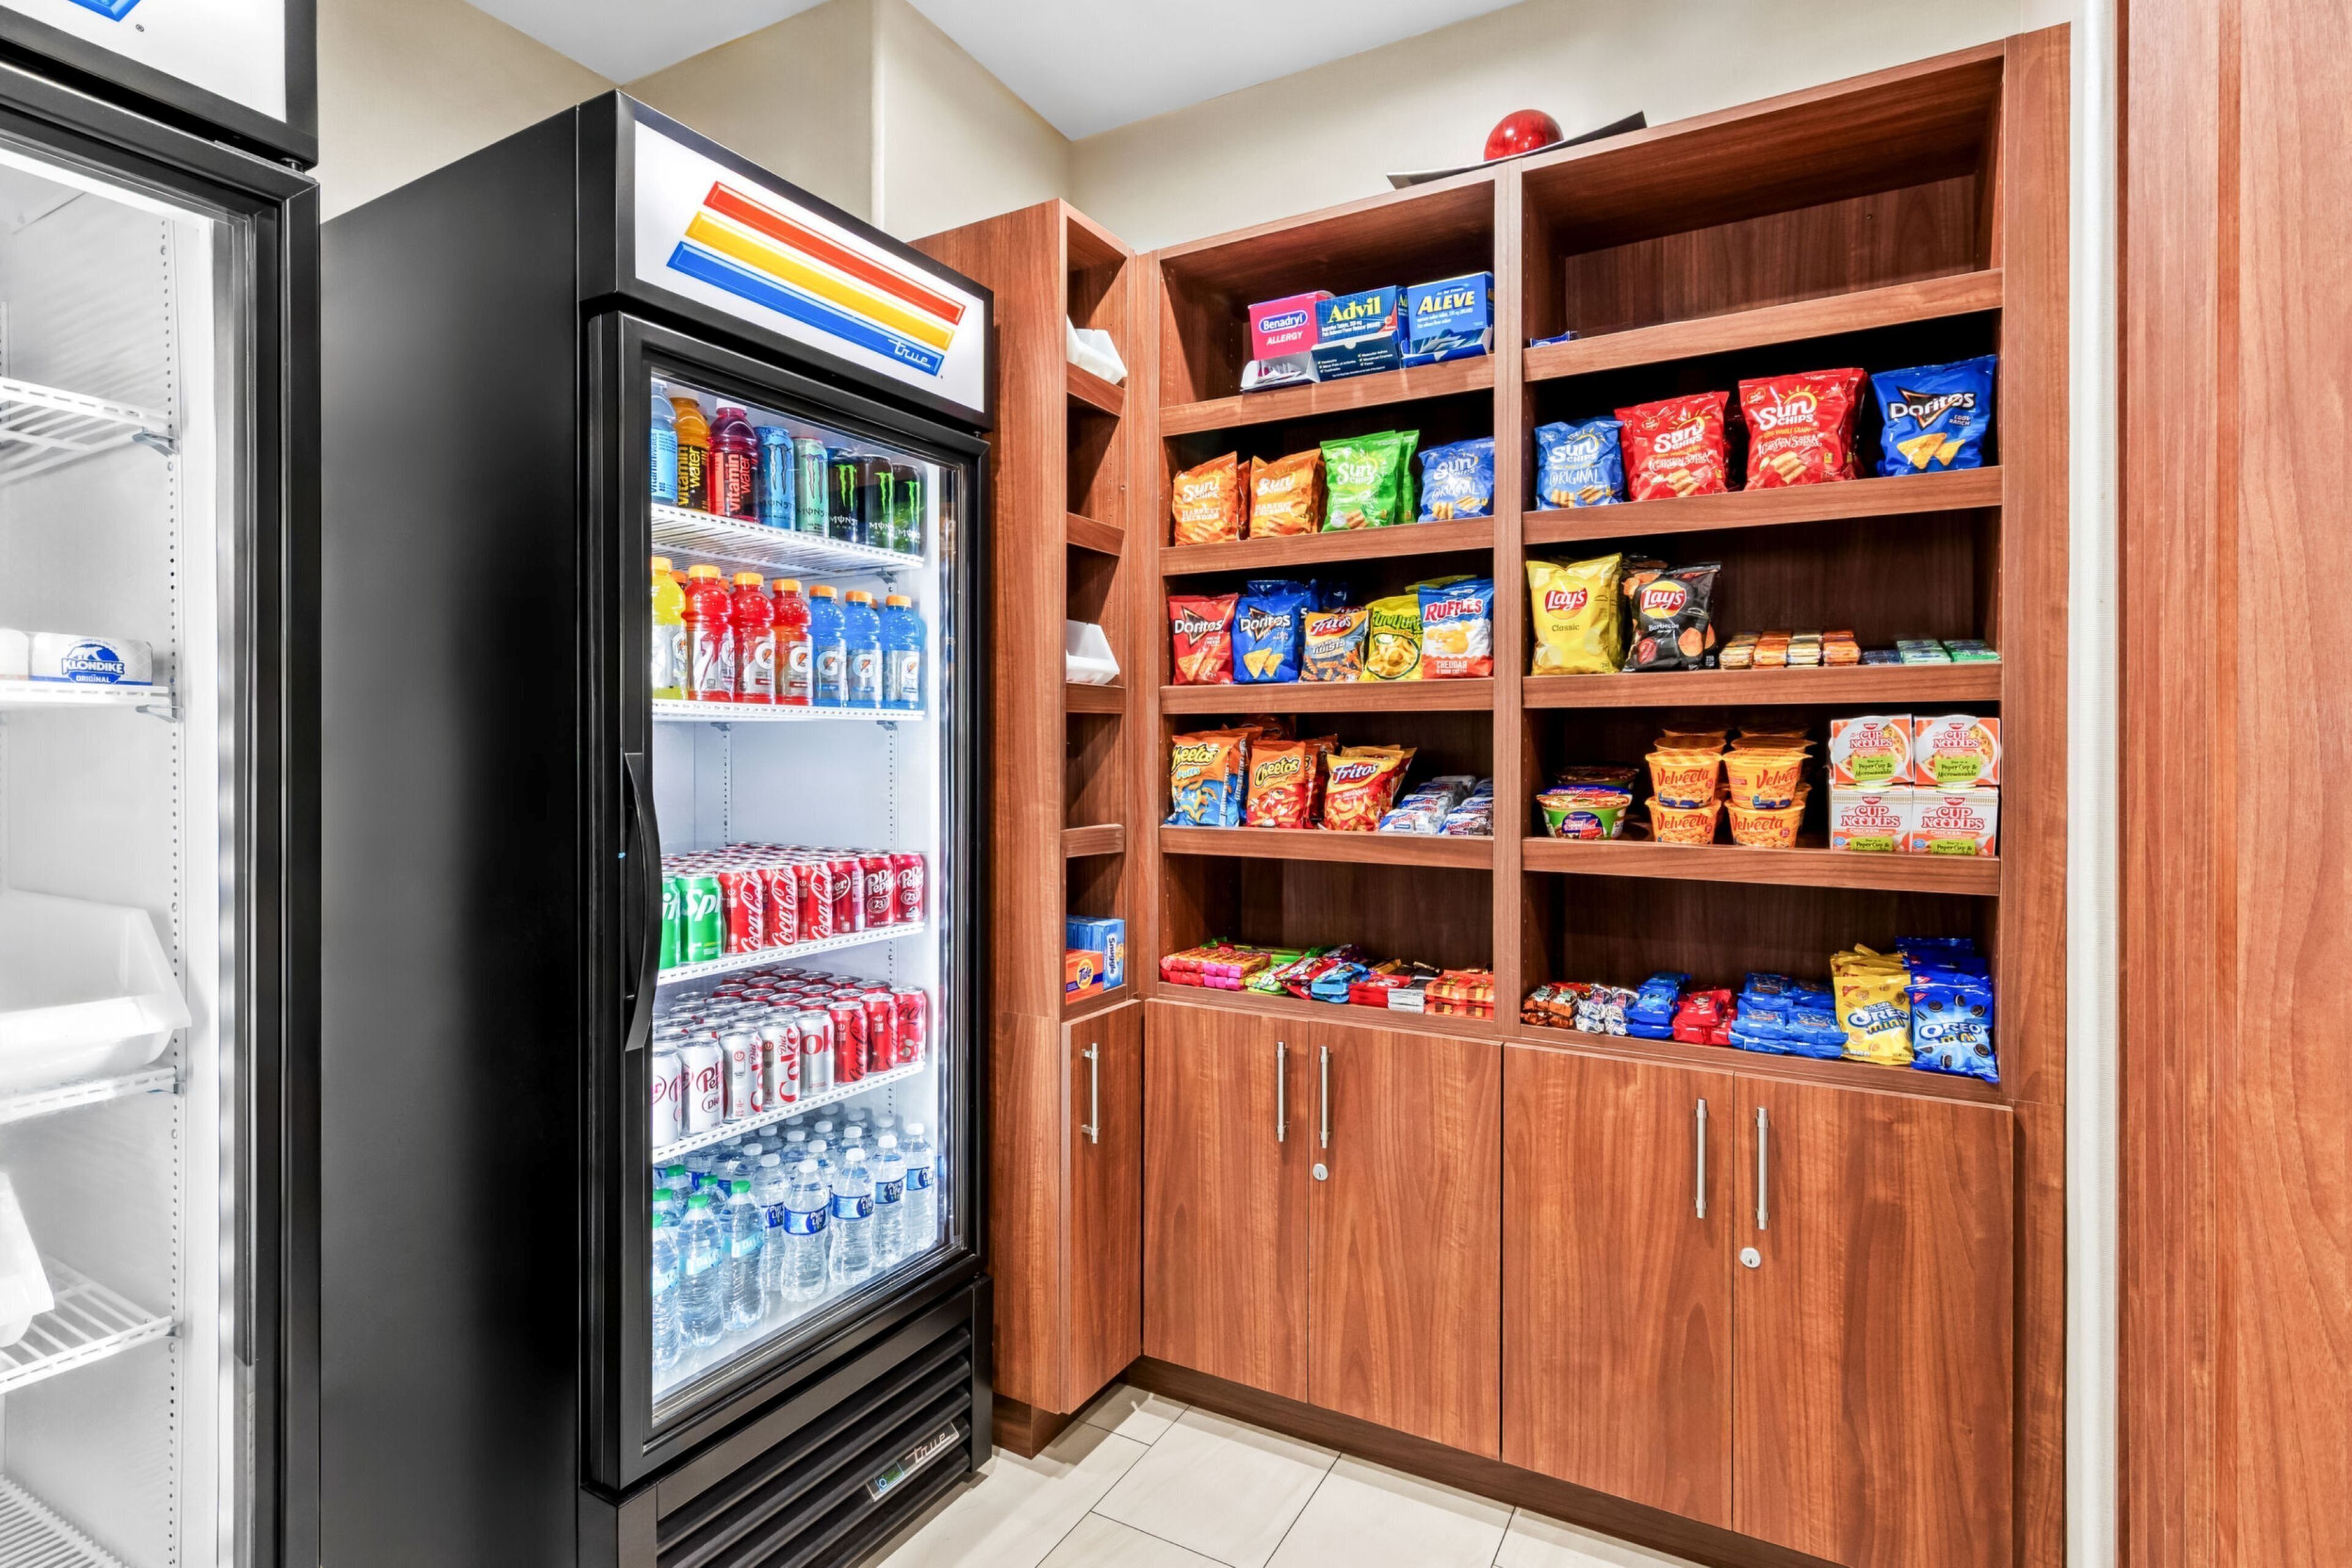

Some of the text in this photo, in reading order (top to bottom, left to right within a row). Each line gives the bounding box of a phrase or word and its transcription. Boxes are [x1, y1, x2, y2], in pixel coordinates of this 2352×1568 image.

[1328, 296, 1381, 323] Advil
[1417, 291, 1475, 315] ALEVE
[1263, 314, 1304, 331] Benadryl
[1266, 331, 1303, 345] ALLERGY
[1759, 399, 1814, 431] Sun
[1890, 393, 1975, 420] Doritos
[1777, 413, 1814, 426] CHIPS
[1654, 424, 1703, 453] Sun
[1549, 436, 1597, 463] Sun
[1566, 453, 1597, 462] CHIPS
[677, 446, 689, 506] vitamin
[688, 446, 701, 489] water
[740, 454, 751, 494] water
[1337, 461, 1376, 486] Sun
[726, 453, 741, 511] vitamin
[1549, 468, 1603, 486] ORIGINAL
[1182, 479, 1220, 503] Sun
[1547, 589, 1586, 611] Lay's
[1643, 589, 1684, 610] Lay's
[1425, 599, 1483, 622] RUFFLES
[1174, 619, 1224, 634] Doritos
[1240, 614, 1292, 631] Doritos
[1311, 615, 1351, 634] Fritos
[1551, 622, 1580, 632] Classic
[62, 658, 124, 674] KLONDIKE
[1849, 739, 1893, 748] NOODLES
[1859, 730, 1883, 740] CUP
[1933, 739, 1979, 748] NOODLES
[1943, 730, 1969, 740] CUP
[1255, 757, 1300, 787] Cheetos
[1333, 763, 1378, 784] Fritos
[1657, 767, 1709, 786] Velveeta
[1958, 763, 1970, 772] Cup
[1756, 767, 1800, 789] Velvee
[1855, 805, 1890, 816] CUP
[1937, 807, 1973, 818] CUP
[1657, 813, 1708, 831] Velveeta
[1732, 813, 1784, 831] Velveeta
[1841, 815, 1901, 827] NOODLES
[1921, 816, 1985, 829] NOODLES
[1078, 966, 1092, 985] Tide
[1864, 1002, 1892, 1011] GOLDEN
[1850, 1009, 1909, 1026] OREO
[1868, 1018, 1906, 1033] mini
[1920, 1023, 1981, 1038] OREO
[779, 1027, 800, 1103] Coke
